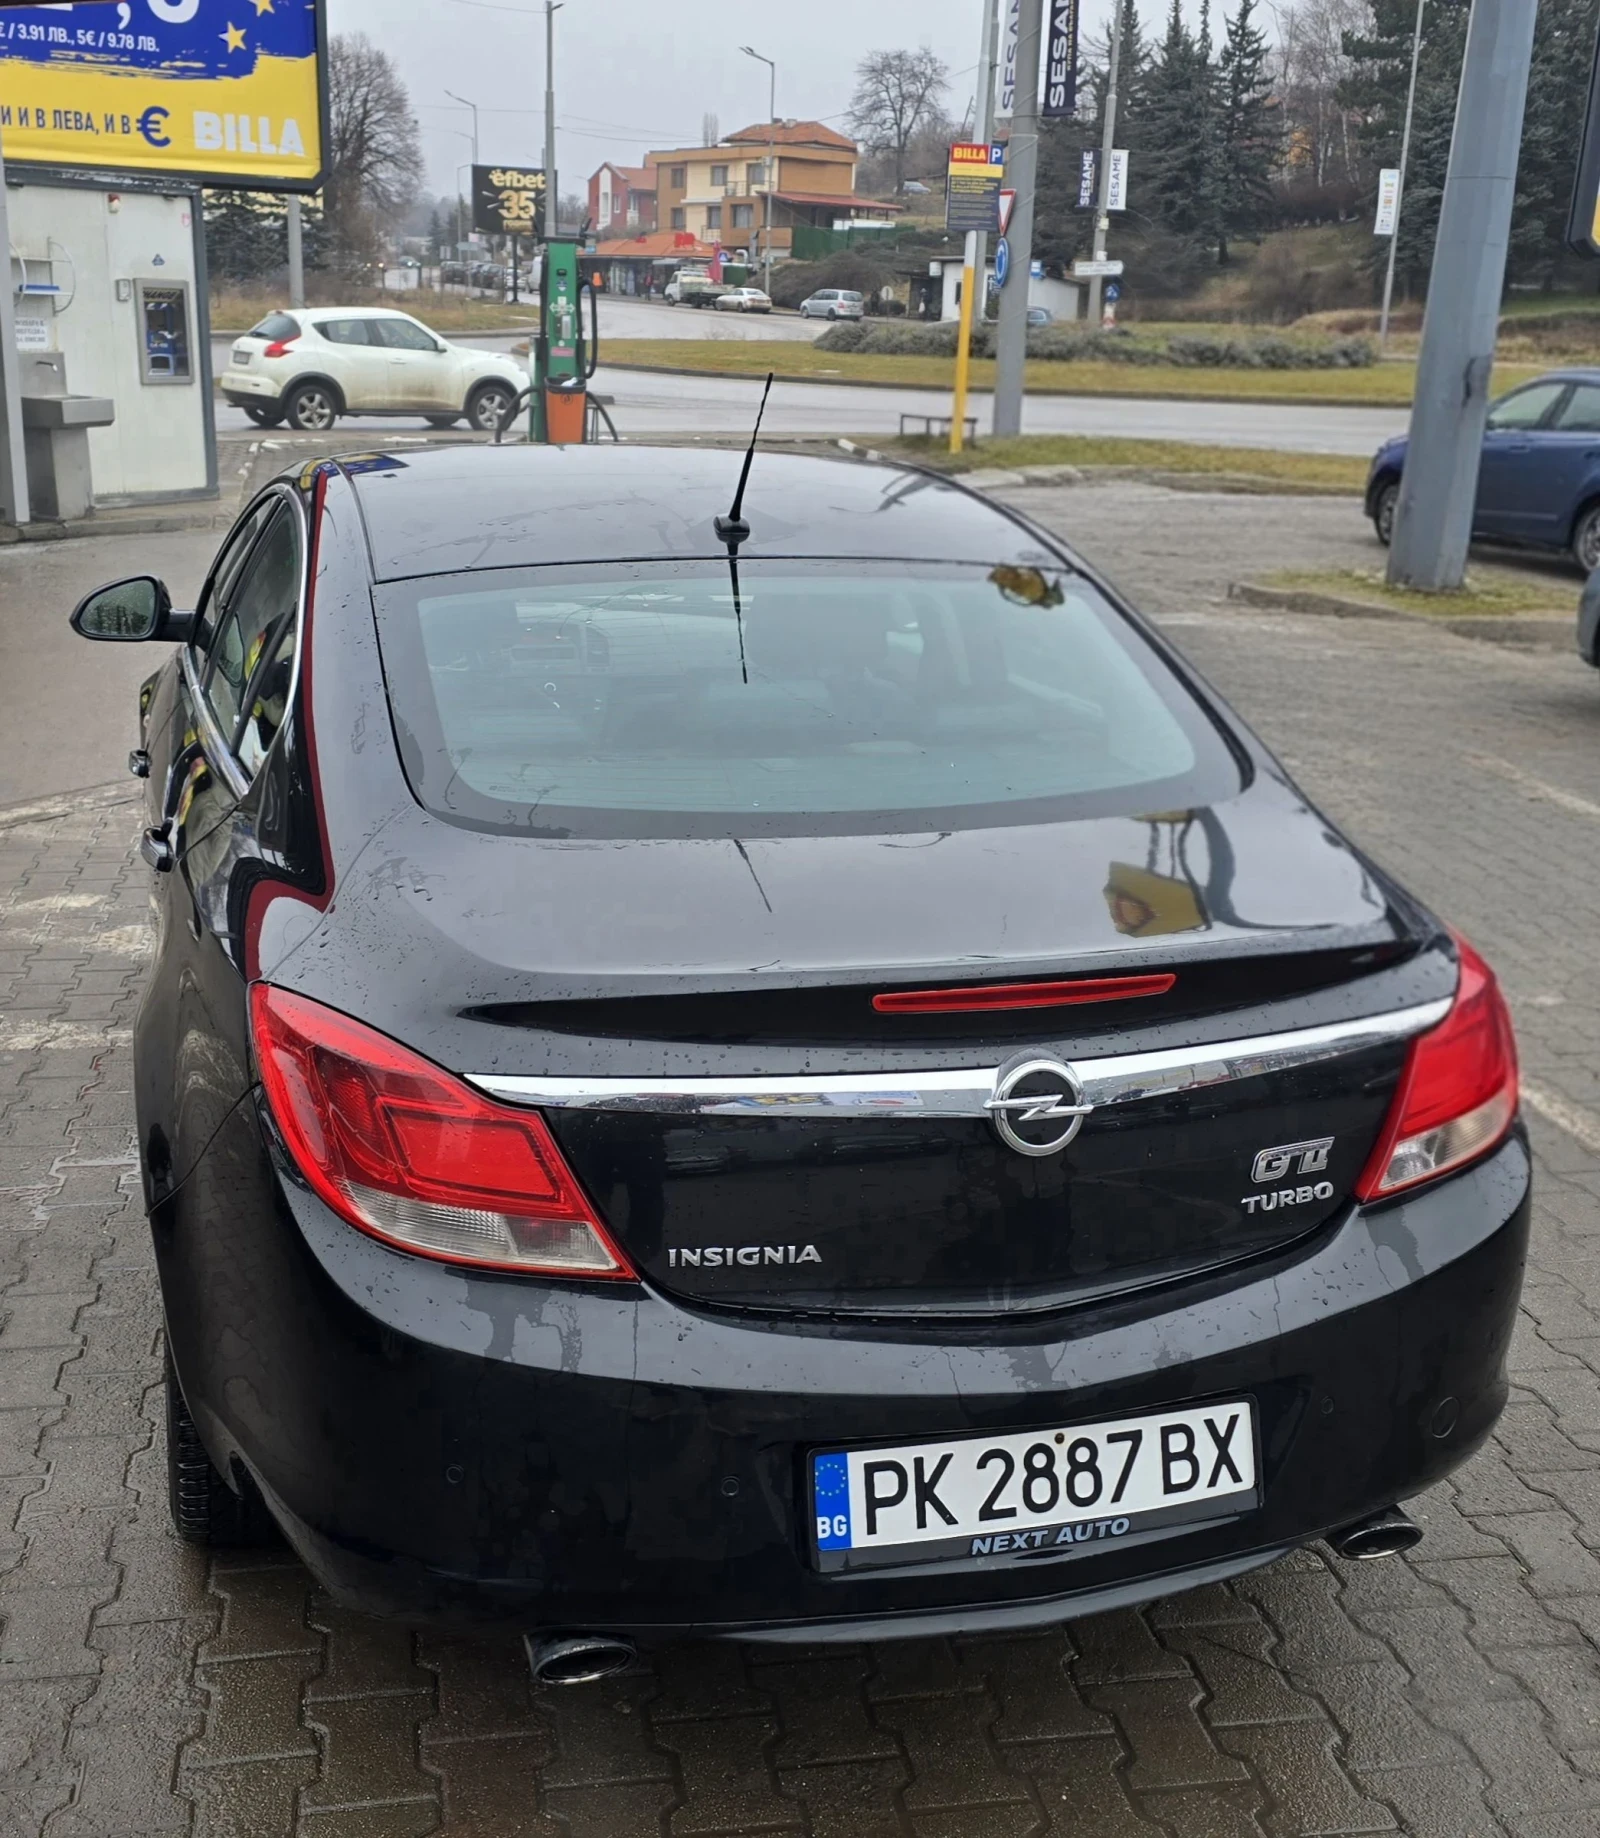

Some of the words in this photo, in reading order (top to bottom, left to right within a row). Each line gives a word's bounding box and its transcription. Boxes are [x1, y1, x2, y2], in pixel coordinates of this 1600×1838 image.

[17, 24, 45, 41] 3.91
[77, 30, 96, 46] 5€
[107, 33, 135, 49] 9.78
[137, 36, 160, 52] ЛВ.
[18, 106, 29, 127] И
[36, 107, 46, 129] В
[53, 109, 99, 135] ЛЕВА,
[104, 113, 116, 134] И
[121, 114, 131, 134] В
[136, 105, 172, 148] €
[193, 111, 305, 156] BILLA
[952, 147, 986, 160] BILLA
[1080, 151, 1094, 206] SESAME
[1110, 153, 1121, 206] SESAME
[498, 190, 536, 219] 35
[1241, 1181, 1334, 1213] TURBO
[668, 1245, 823, 1267] INSIGNIA
[863, 1453, 959, 1536] PK
[976, 1429, 1143, 1522] 2887
[1160, 1414, 1243, 1496] BX
[817, 1514, 848, 1539] BG
[971, 1530, 1049, 1556] NEXT
[1055, 1517, 1131, 1544] AUTO
